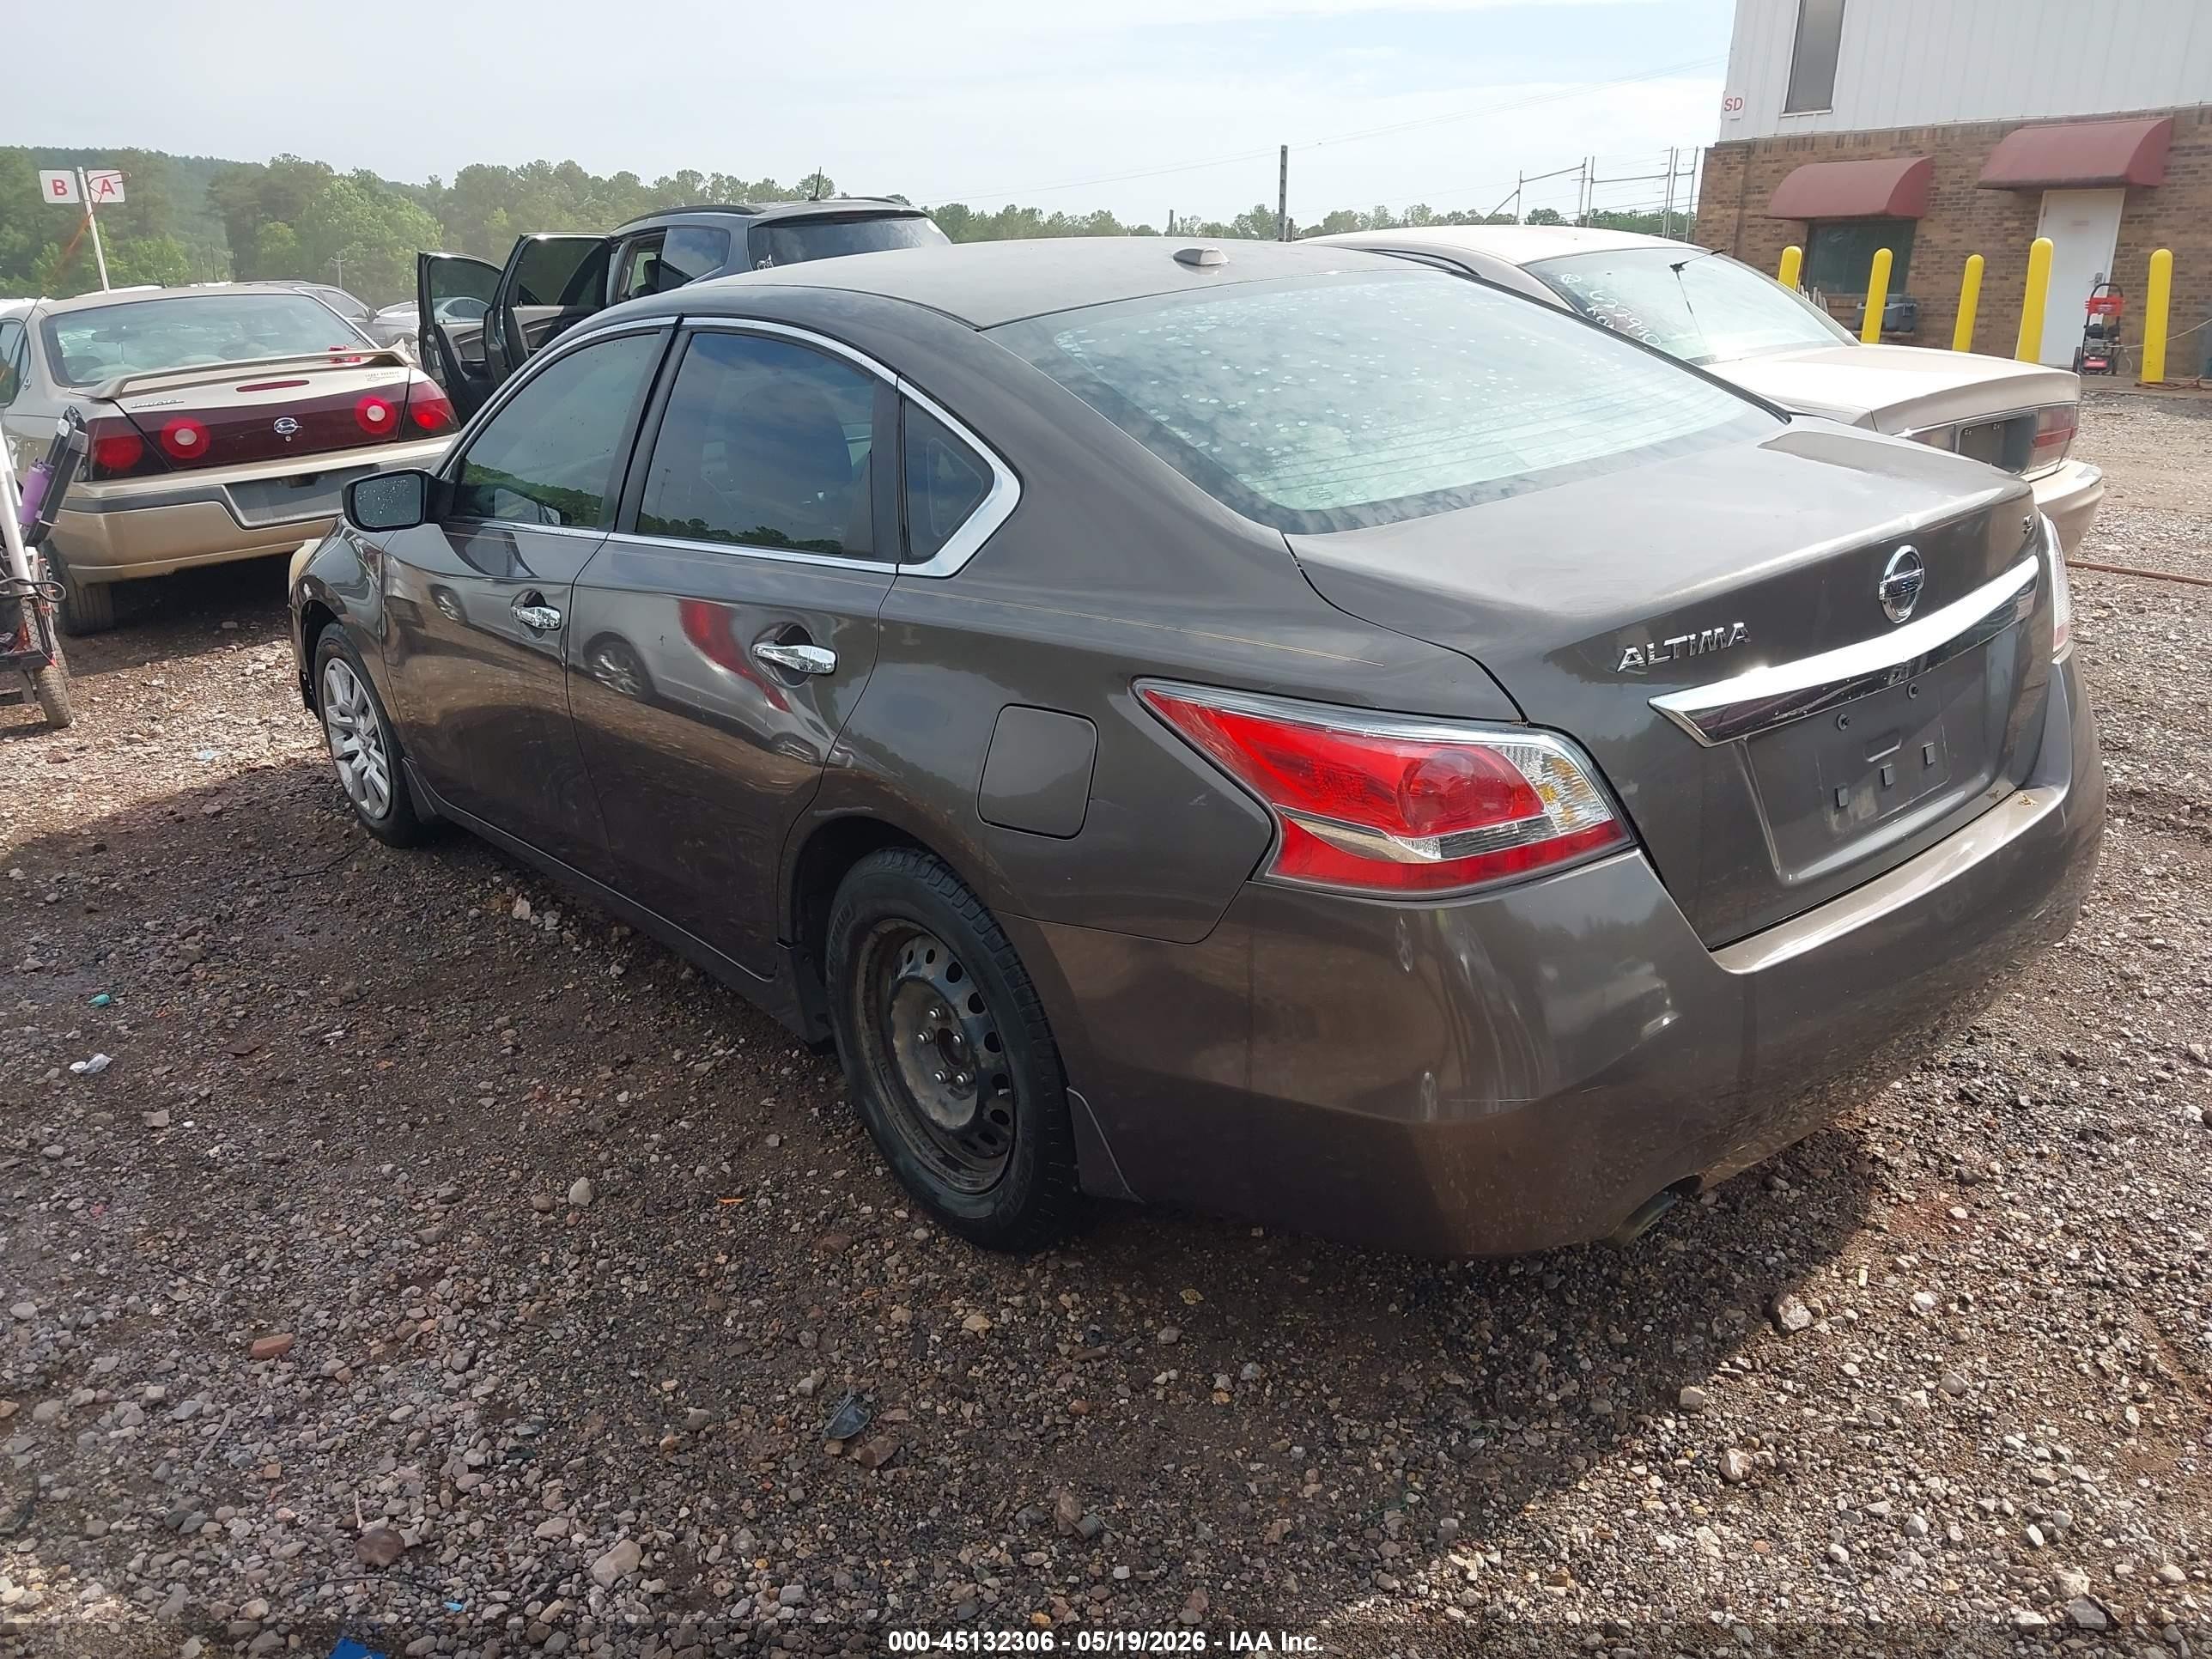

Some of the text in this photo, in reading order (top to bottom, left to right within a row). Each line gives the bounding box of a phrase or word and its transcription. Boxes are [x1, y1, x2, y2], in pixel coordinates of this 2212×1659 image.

[1723, 97, 1744, 112] SD
[52, 179, 68, 196] B
[100, 179, 116, 196] A
[1616, 622, 1752, 673] ALTIMA
